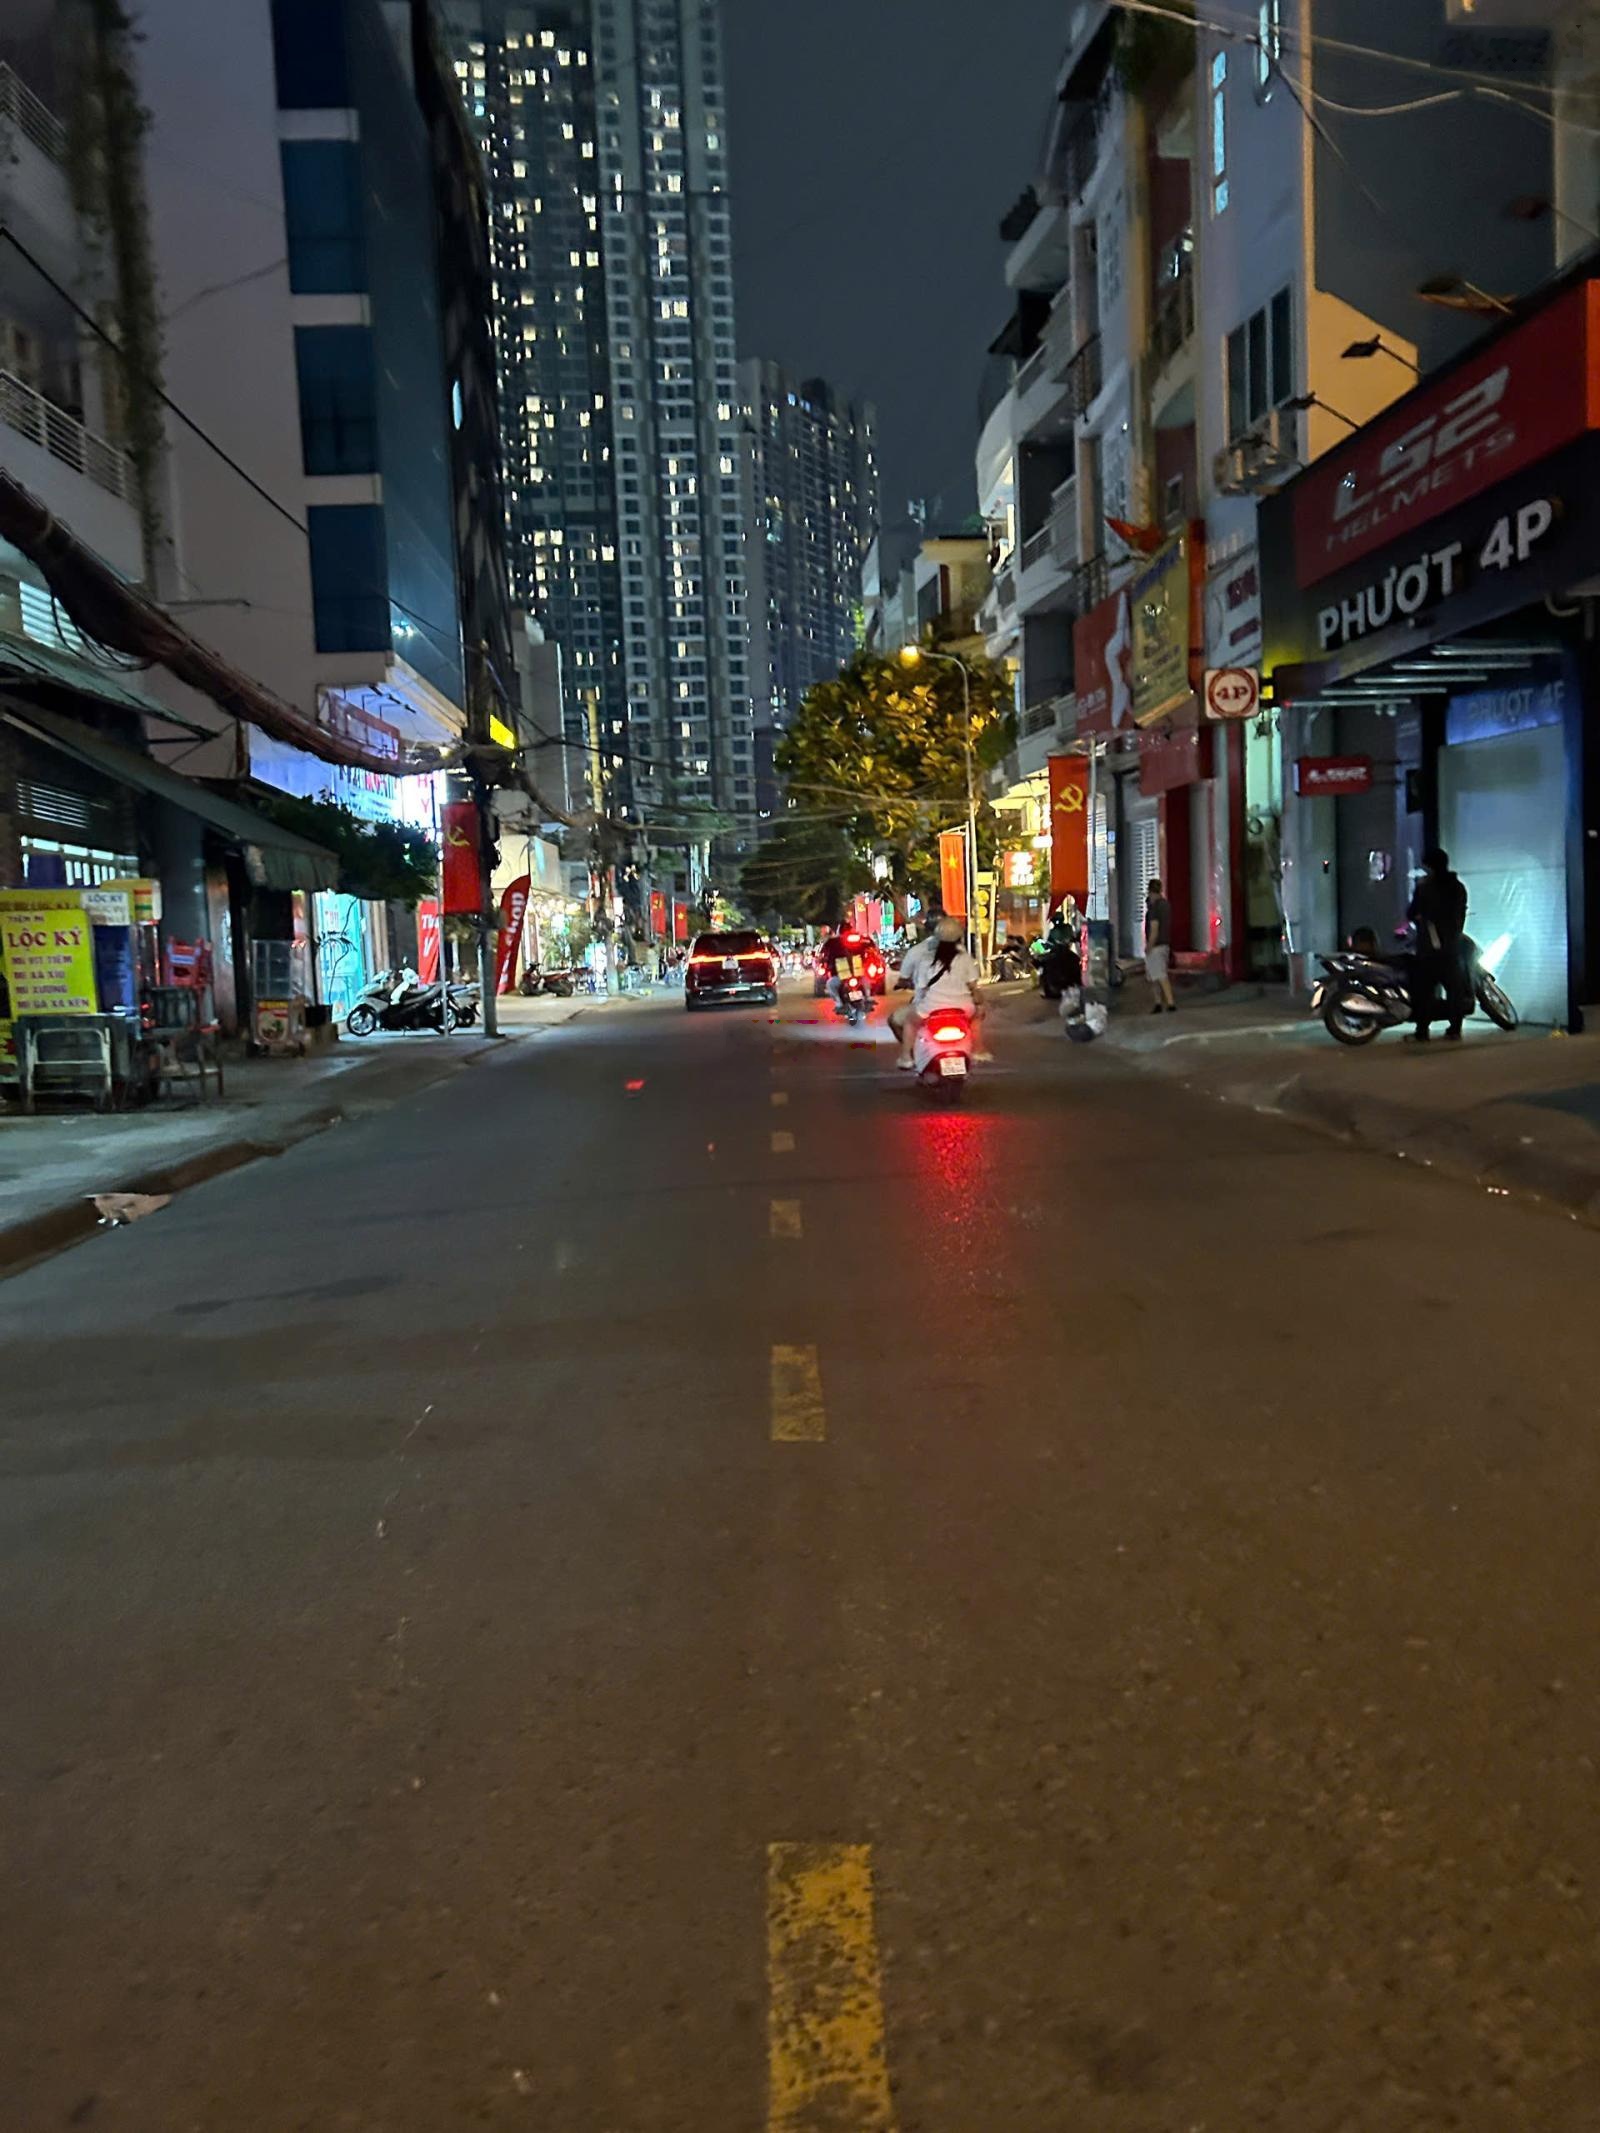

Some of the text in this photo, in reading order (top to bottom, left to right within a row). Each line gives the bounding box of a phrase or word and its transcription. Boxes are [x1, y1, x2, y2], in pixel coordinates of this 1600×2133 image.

[1325, 423, 1516, 552] HELMETS
[1333, 366, 1510, 520] LS2
[1318, 541, 1462, 650] PHƯỢT
[1479, 498, 1553, 571] 4P
[7, 927, 47, 952] LỘC
